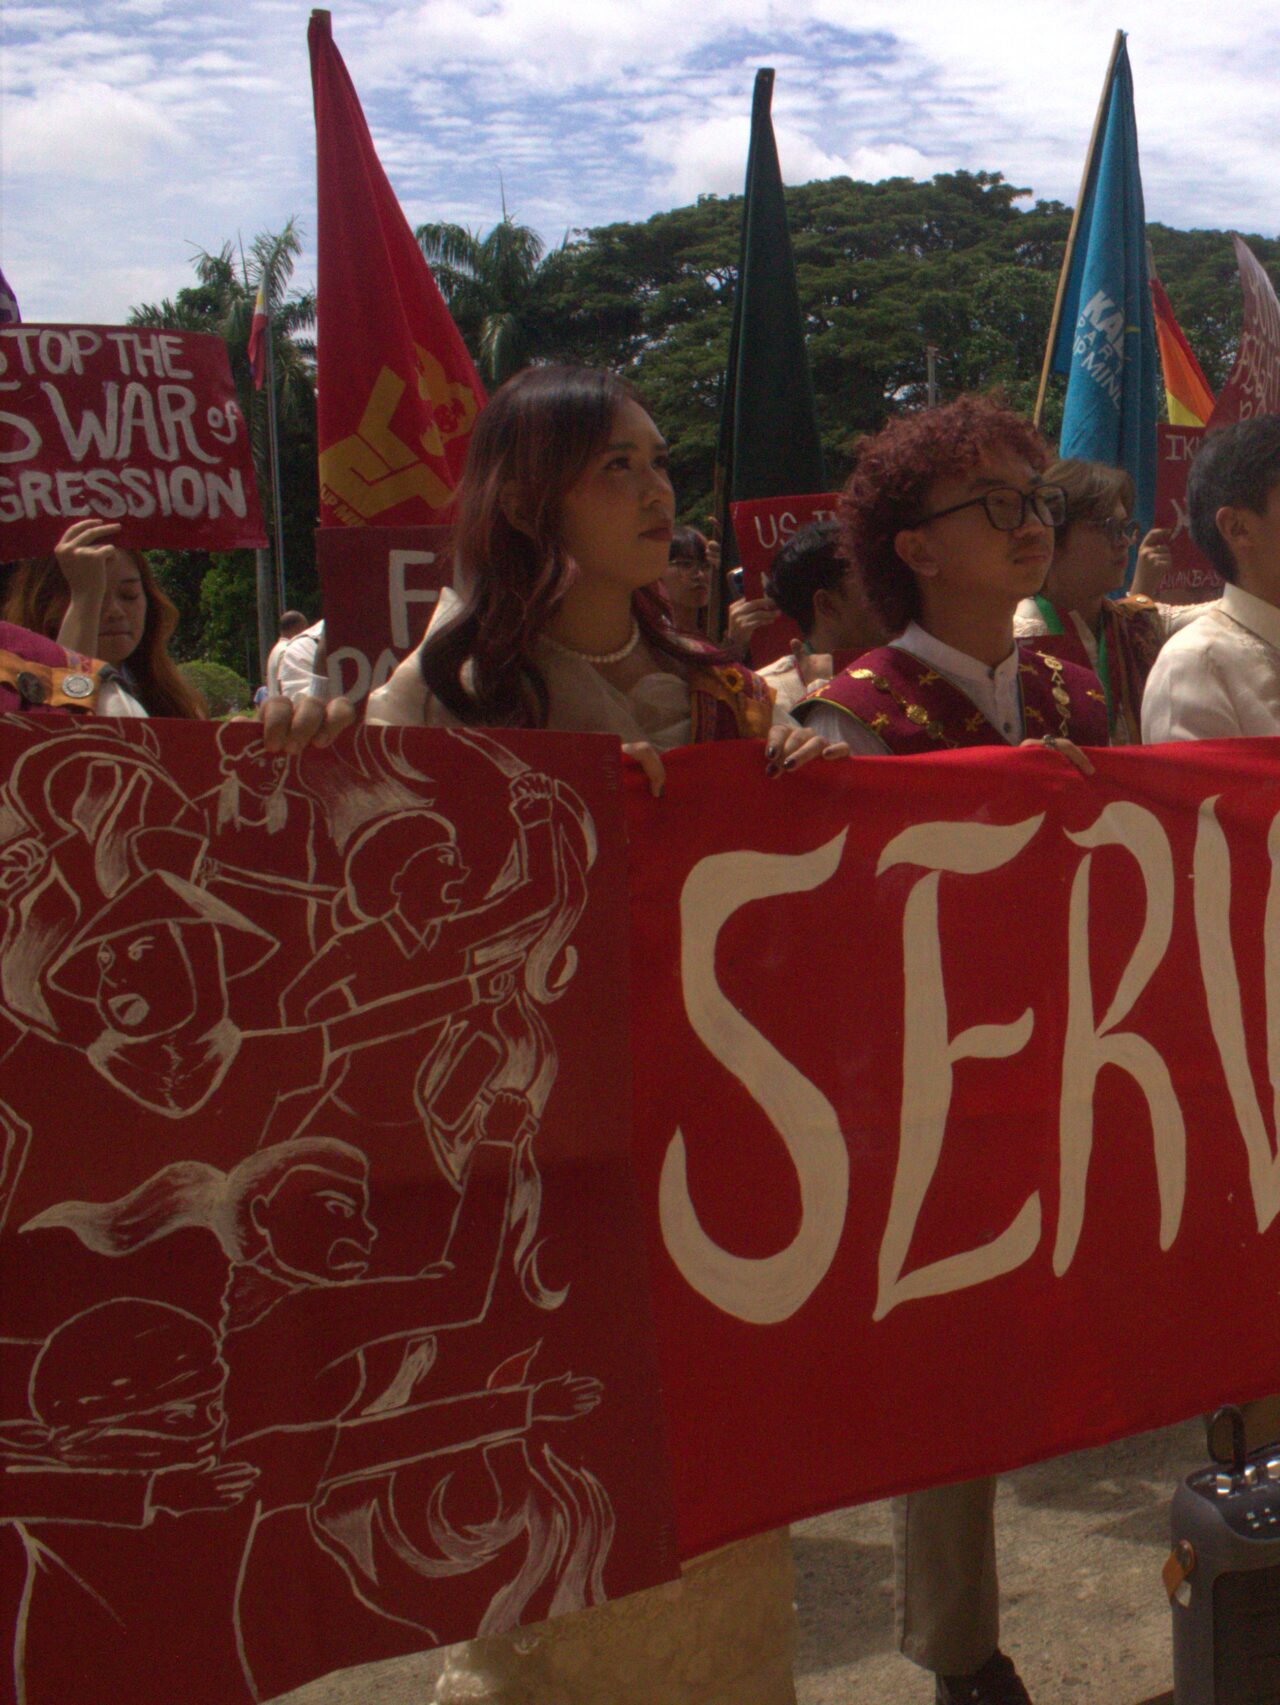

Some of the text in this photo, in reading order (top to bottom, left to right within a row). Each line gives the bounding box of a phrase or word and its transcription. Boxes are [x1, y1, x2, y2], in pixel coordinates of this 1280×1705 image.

[106, 333, 195, 379] THE
[40, 381, 222, 465] WAR
[207, 400, 239, 444] of
